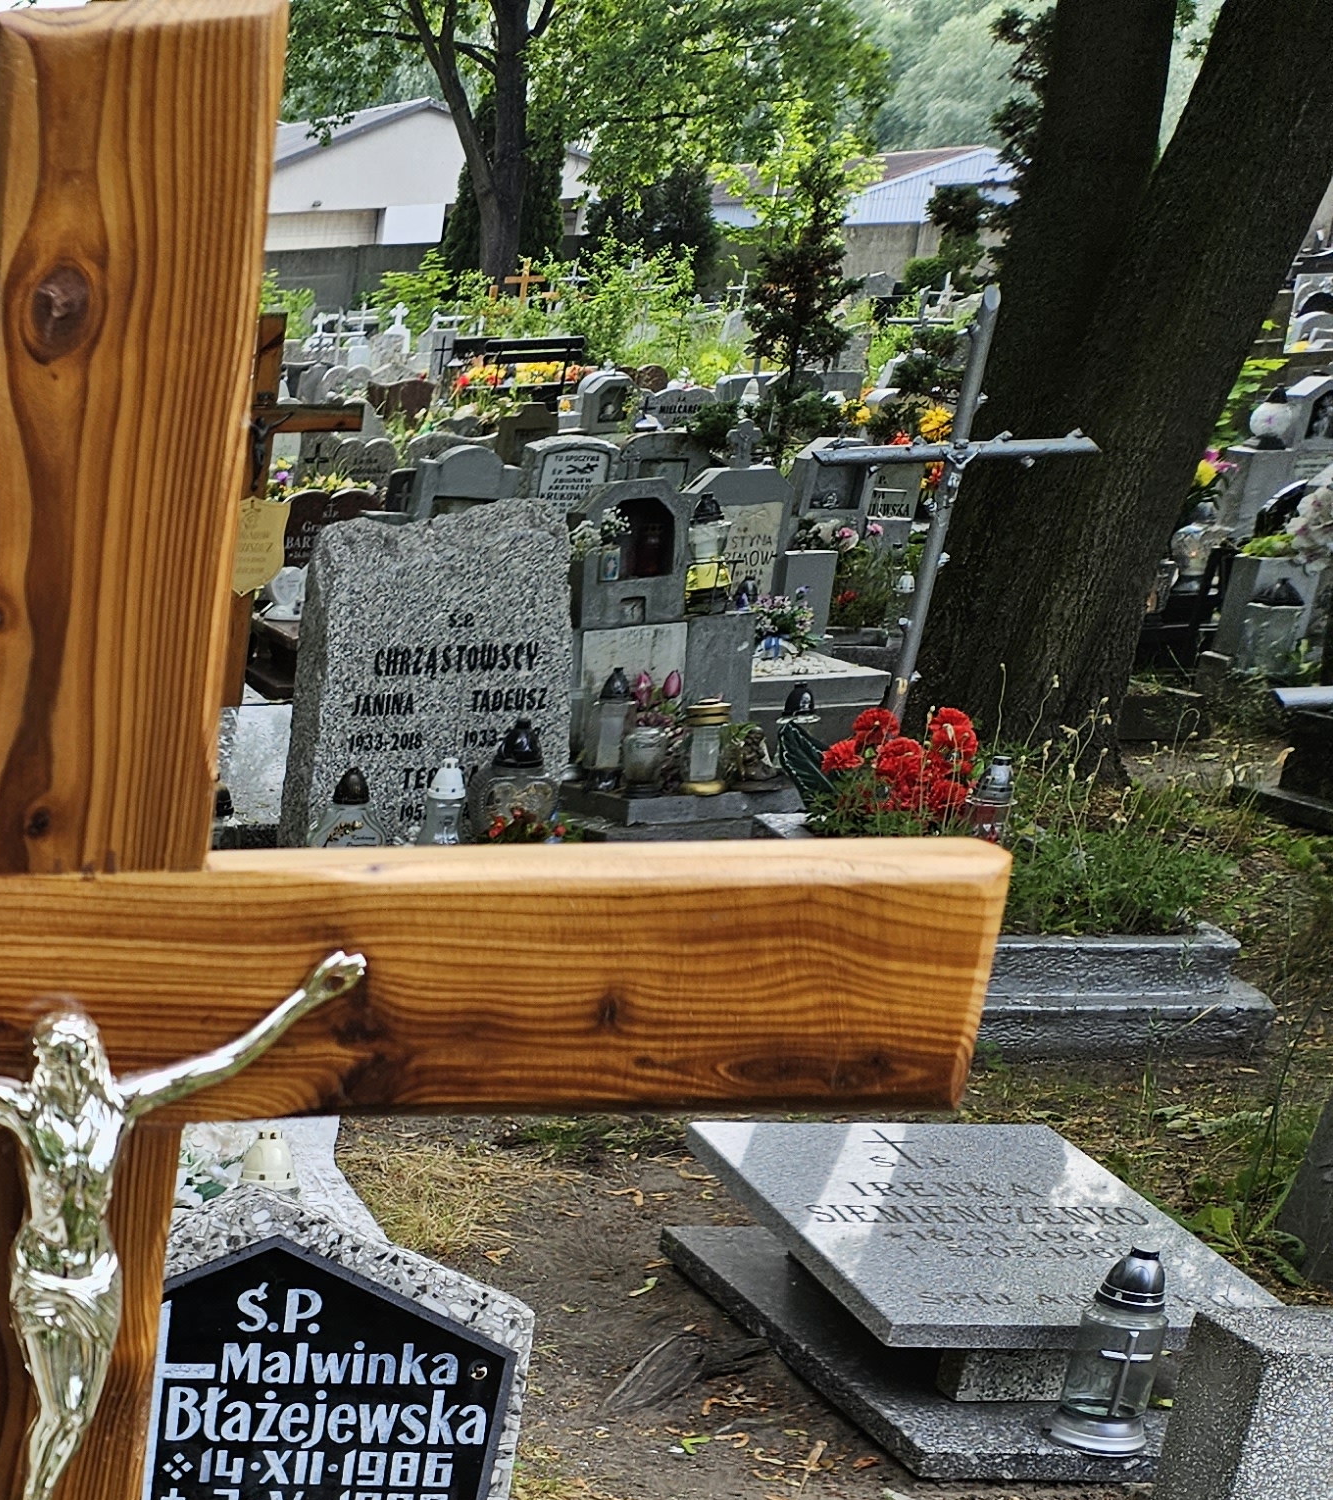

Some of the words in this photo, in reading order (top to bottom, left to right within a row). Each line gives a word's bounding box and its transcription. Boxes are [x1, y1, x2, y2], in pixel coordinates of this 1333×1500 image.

[374, 642, 539, 680] CHRZĄSTOWSCY
[352, 693, 414, 716] JANINA
[471, 688, 548, 712] TADEUSZ
[237, 1282, 323, 1335] Ś.P.
[220, 1341, 459, 1386] Malwinka
[165, 1387, 488, 1446] Błażejewska
